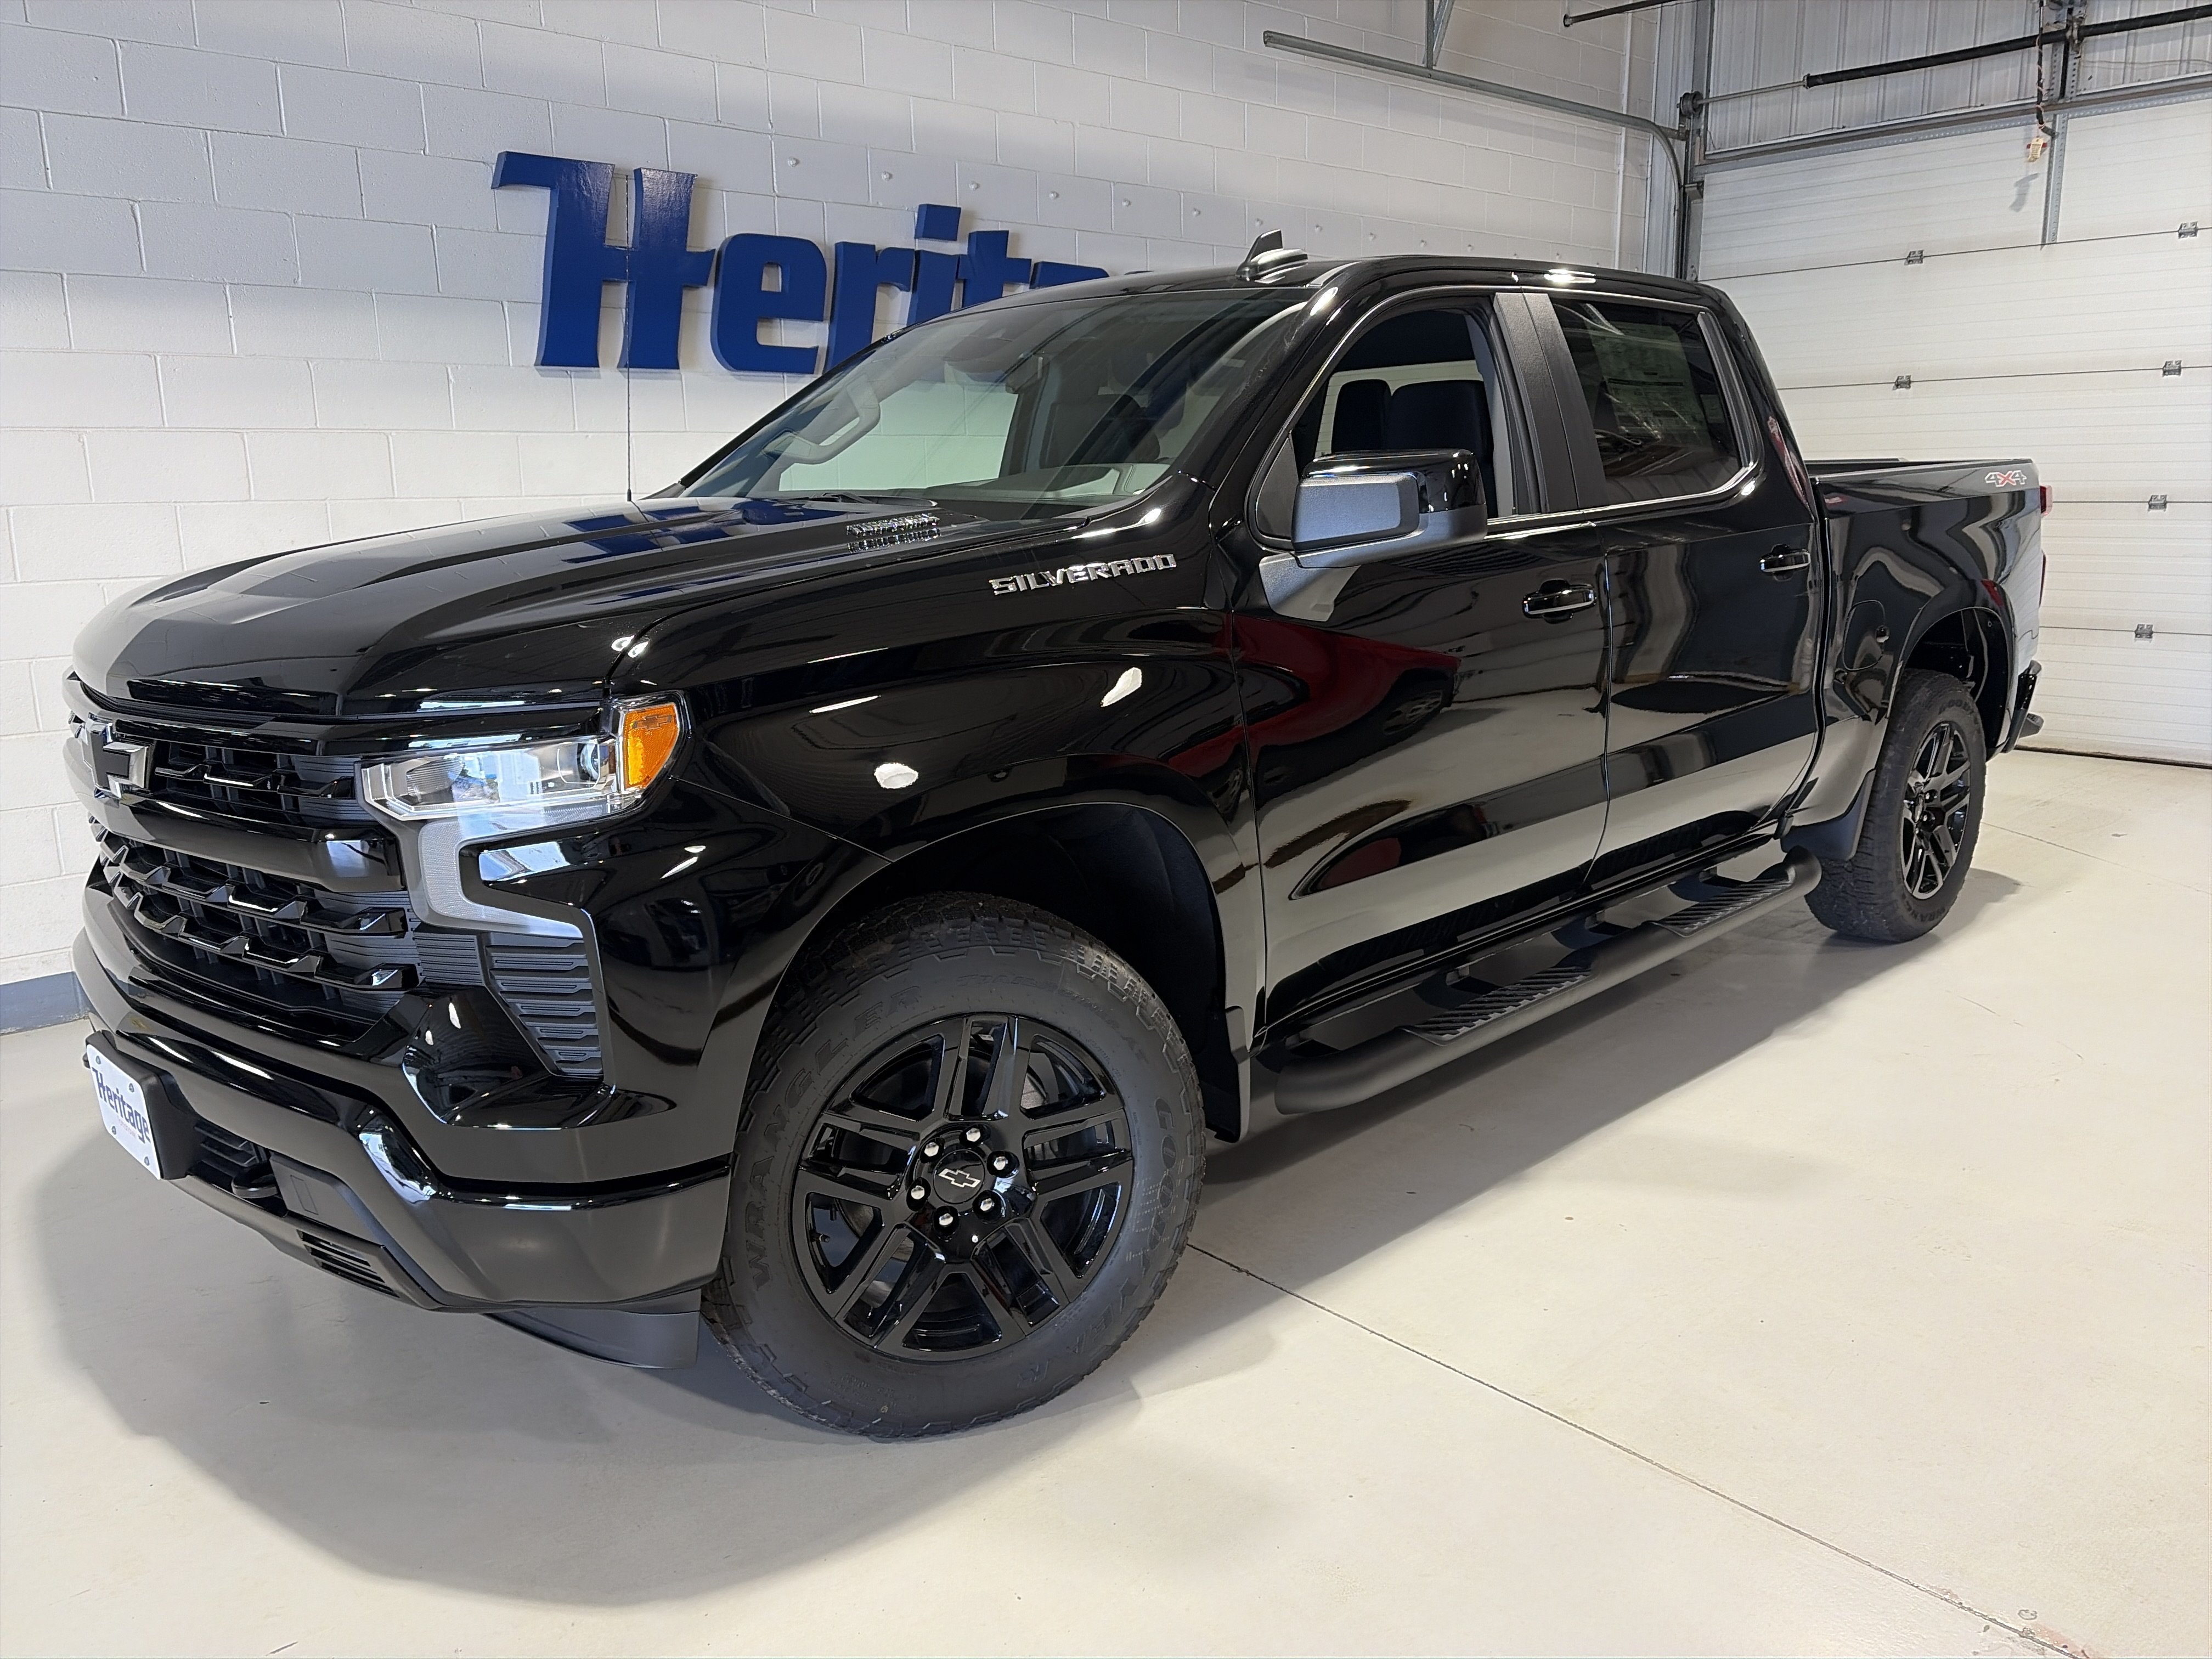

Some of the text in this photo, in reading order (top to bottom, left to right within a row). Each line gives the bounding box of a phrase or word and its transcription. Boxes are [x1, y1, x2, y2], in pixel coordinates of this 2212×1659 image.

[491, 151, 1155, 375] Herit
[989, 554, 1177, 596] SILVERADO
[92, 1067, 151, 1144] Heritage
[745, 985, 922, 1291] WRANGLER
[1016, 1097, 1177, 1389] GOODYEAR
